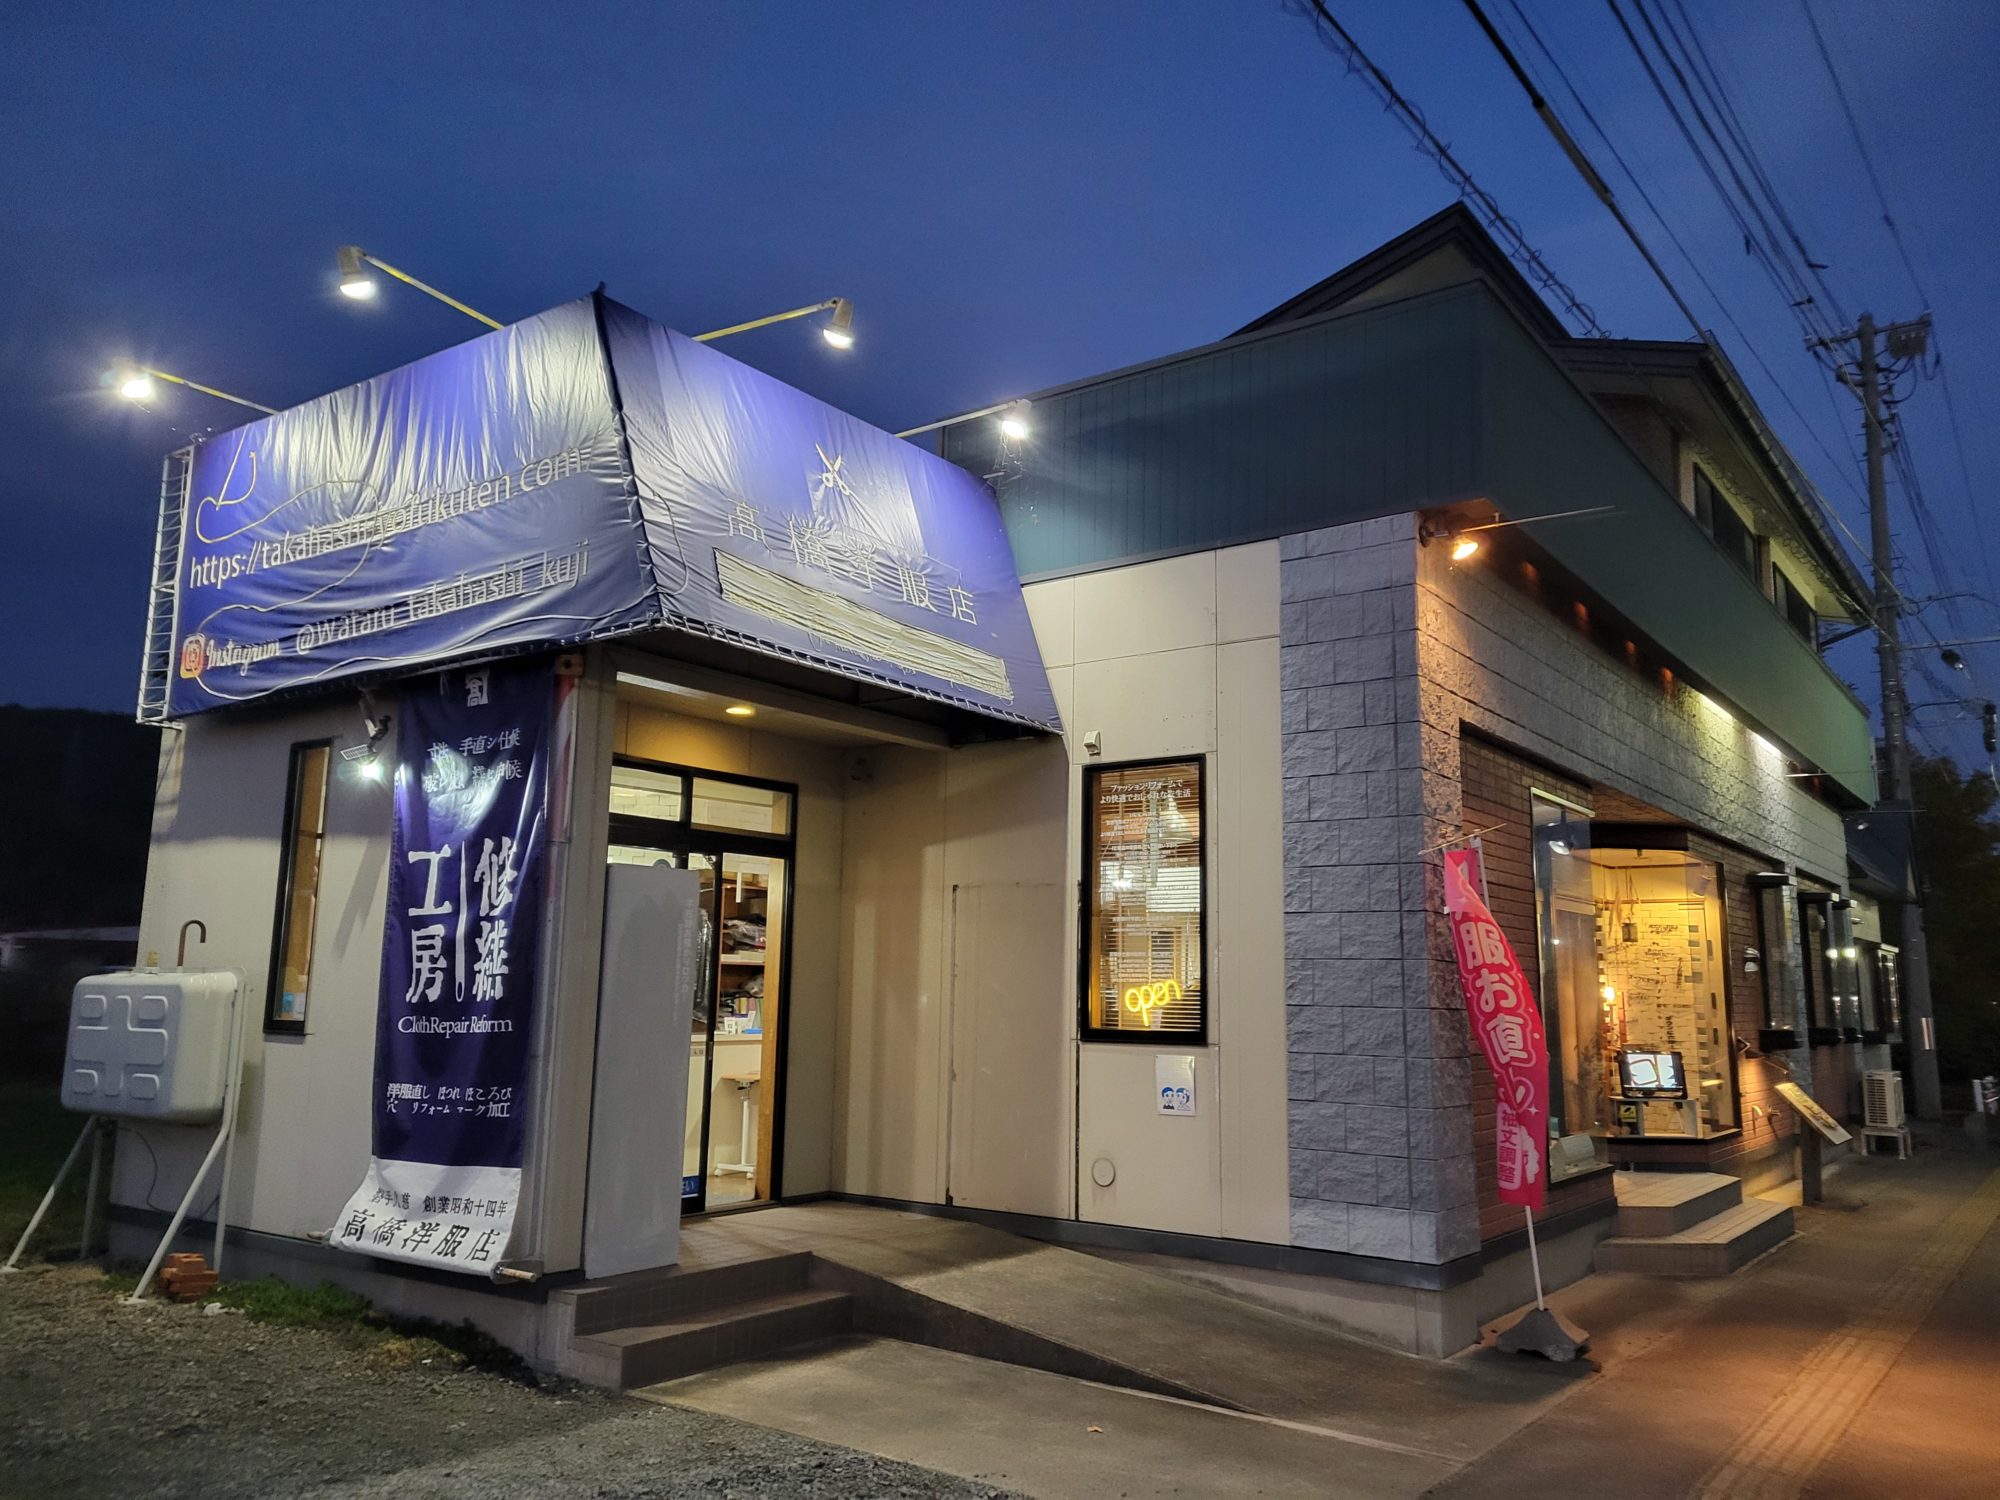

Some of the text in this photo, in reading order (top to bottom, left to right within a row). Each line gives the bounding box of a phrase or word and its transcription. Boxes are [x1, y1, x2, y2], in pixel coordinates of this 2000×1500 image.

[207, 638, 281, 677] Instagram
[405, 843, 453, 1004] 工房
[1125, 978, 1182, 1027] open
[397, 1014, 514, 1039] Cloth Repair Reform
[386, 1082, 513, 1101] 洋服直し ほつれ ほころび
[411, 1101, 450, 1116] リフォーム
[456, 1101, 511, 1118] マーク加工
[422, 1194, 508, 1219] 創業昭和十四年
[341, 1208, 501, 1263] 高橋洋服店
